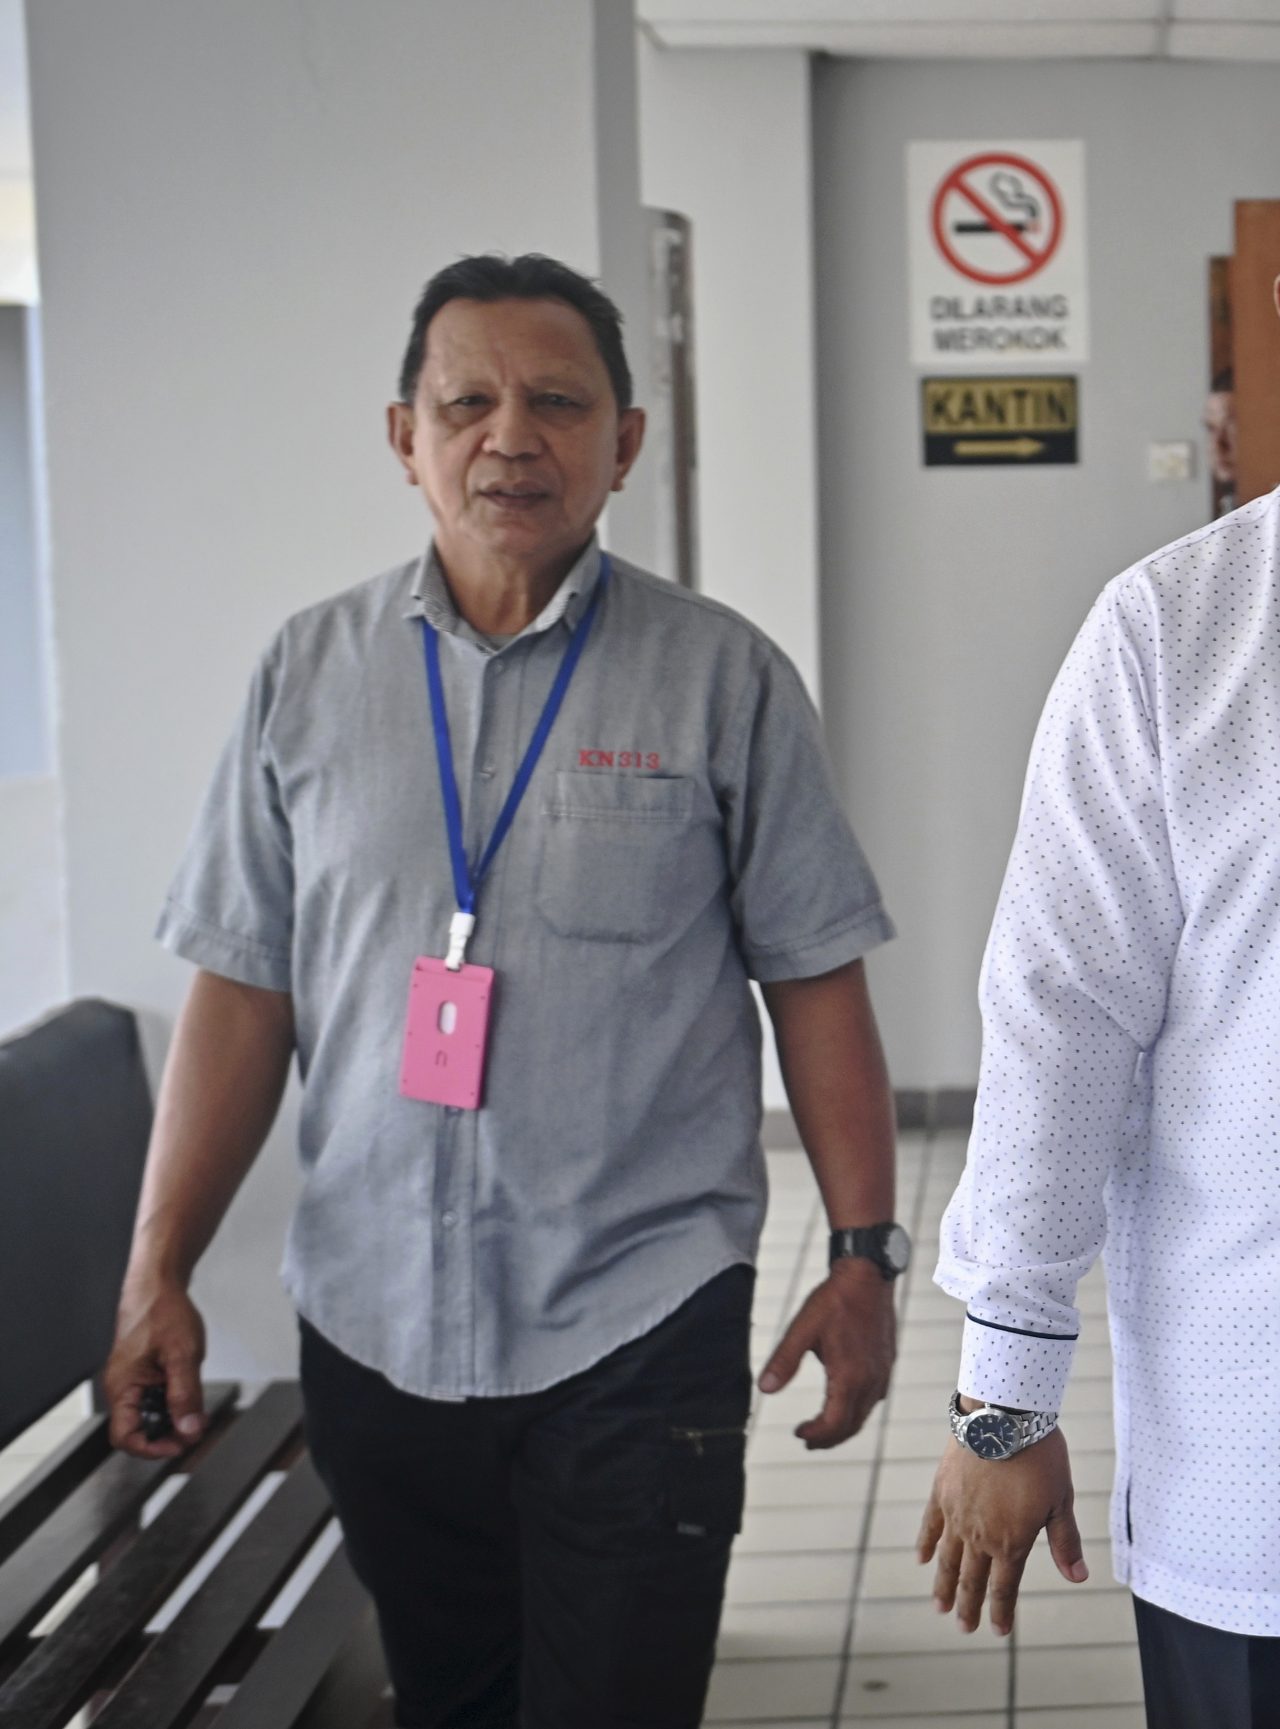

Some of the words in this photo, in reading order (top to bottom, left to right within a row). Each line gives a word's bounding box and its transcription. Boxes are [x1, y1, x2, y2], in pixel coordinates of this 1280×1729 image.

[930, 294, 1068, 320] DILARANG
[933, 326, 1067, 351] MEROKOK
[931, 387, 1071, 425] KANTIN
[578, 748, 661, 770] KN313
